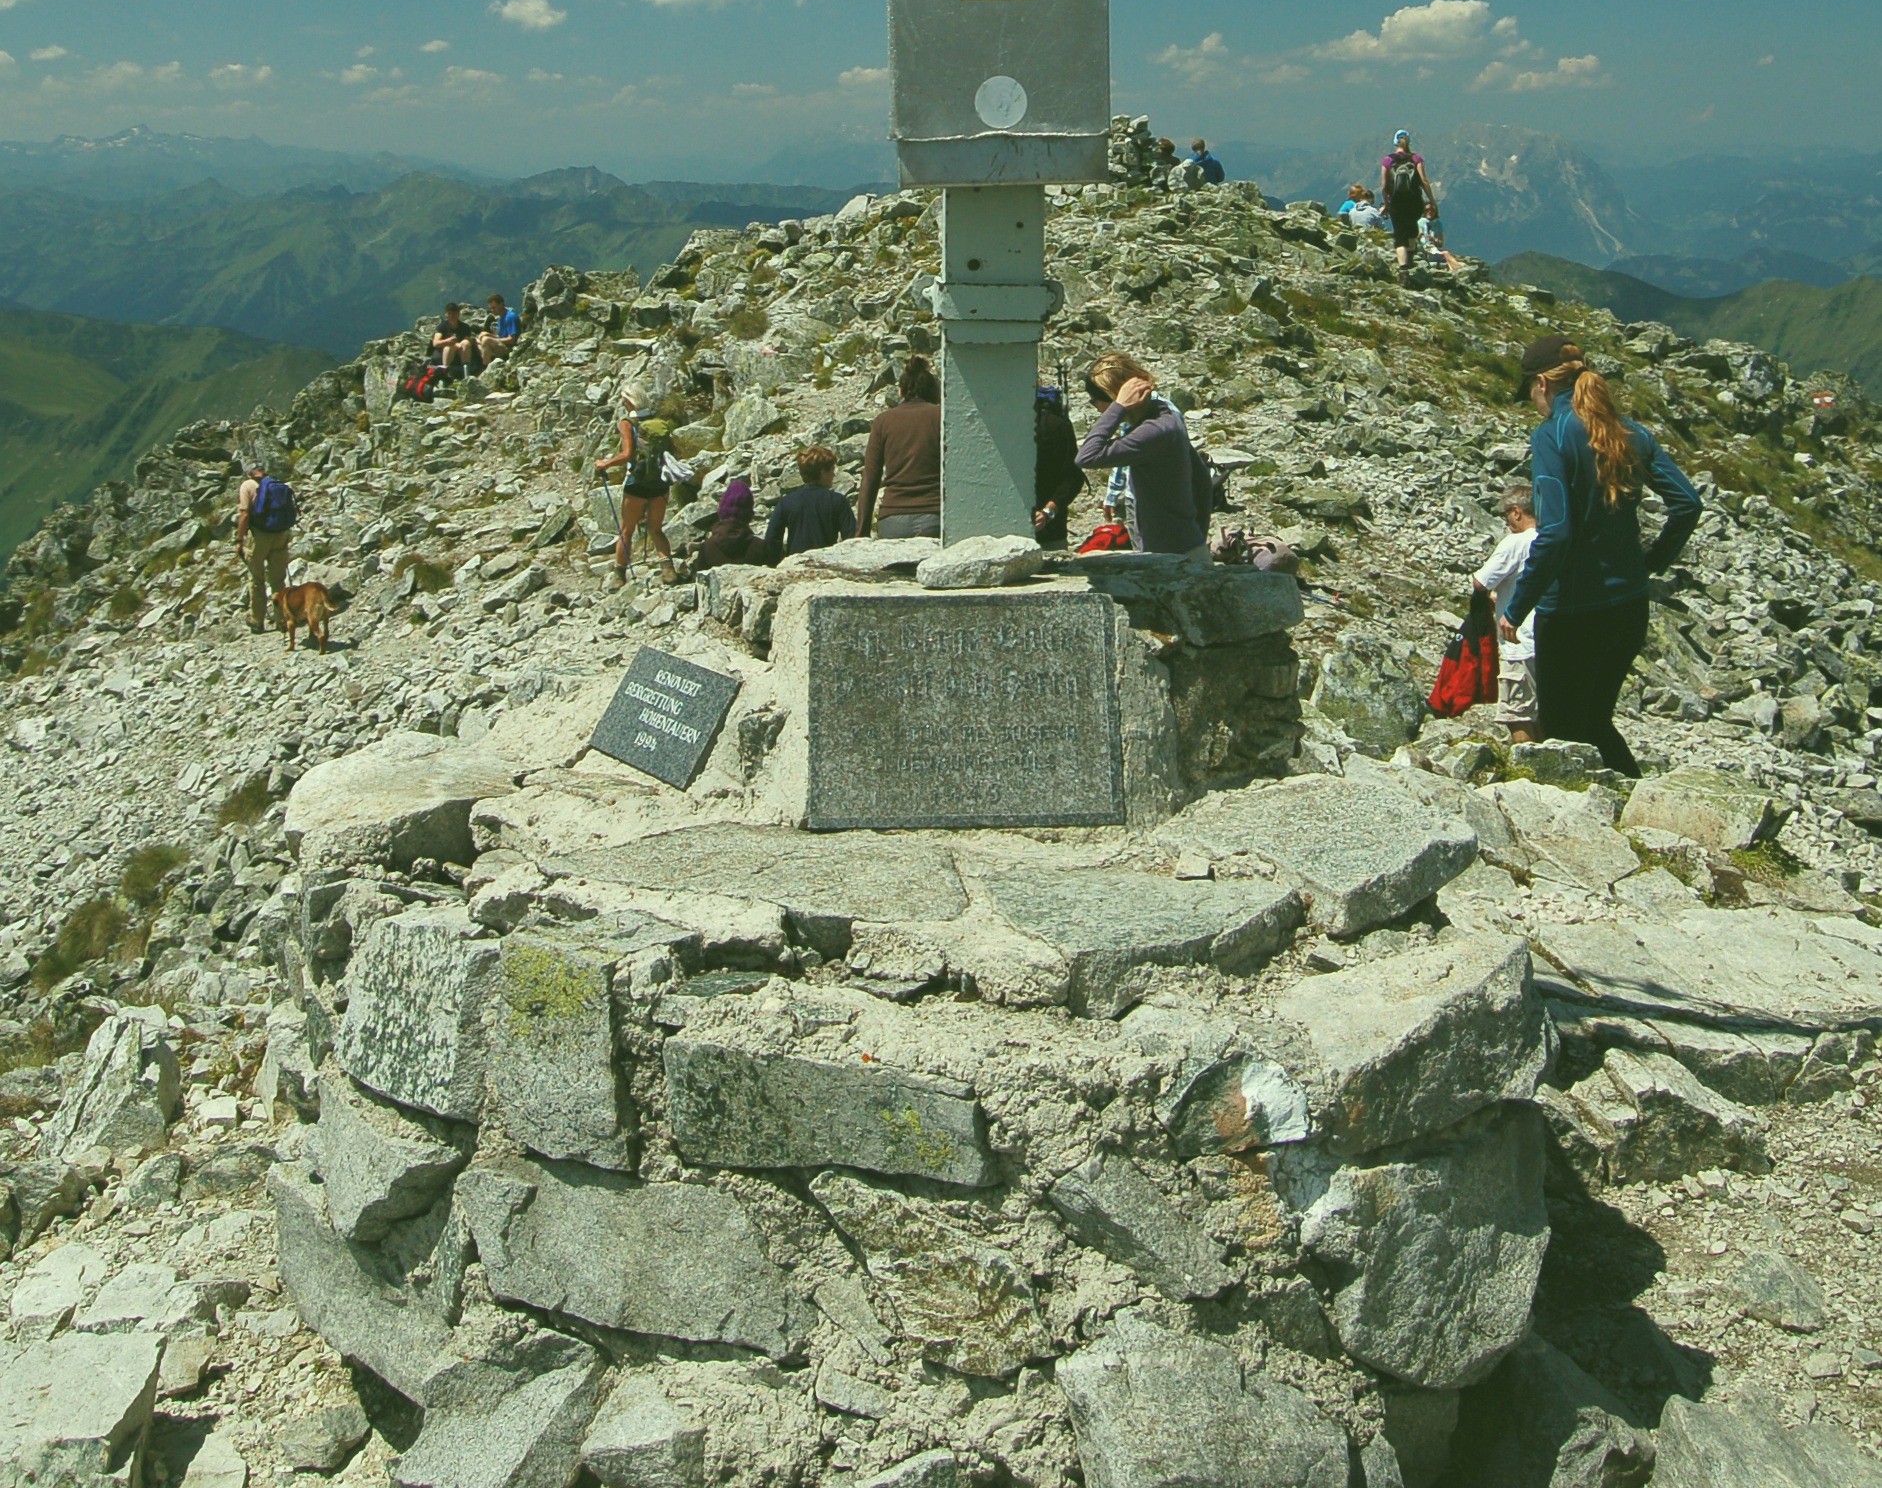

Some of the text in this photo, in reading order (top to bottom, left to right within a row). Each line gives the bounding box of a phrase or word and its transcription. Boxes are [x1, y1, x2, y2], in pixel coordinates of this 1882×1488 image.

[625, 682, 684, 715] BERGRETTUNG
[654, 669, 702, 698] RENOVIERT
[638, 707, 702, 744] HOHENTAUERN
[633, 731, 658, 752] 1994
